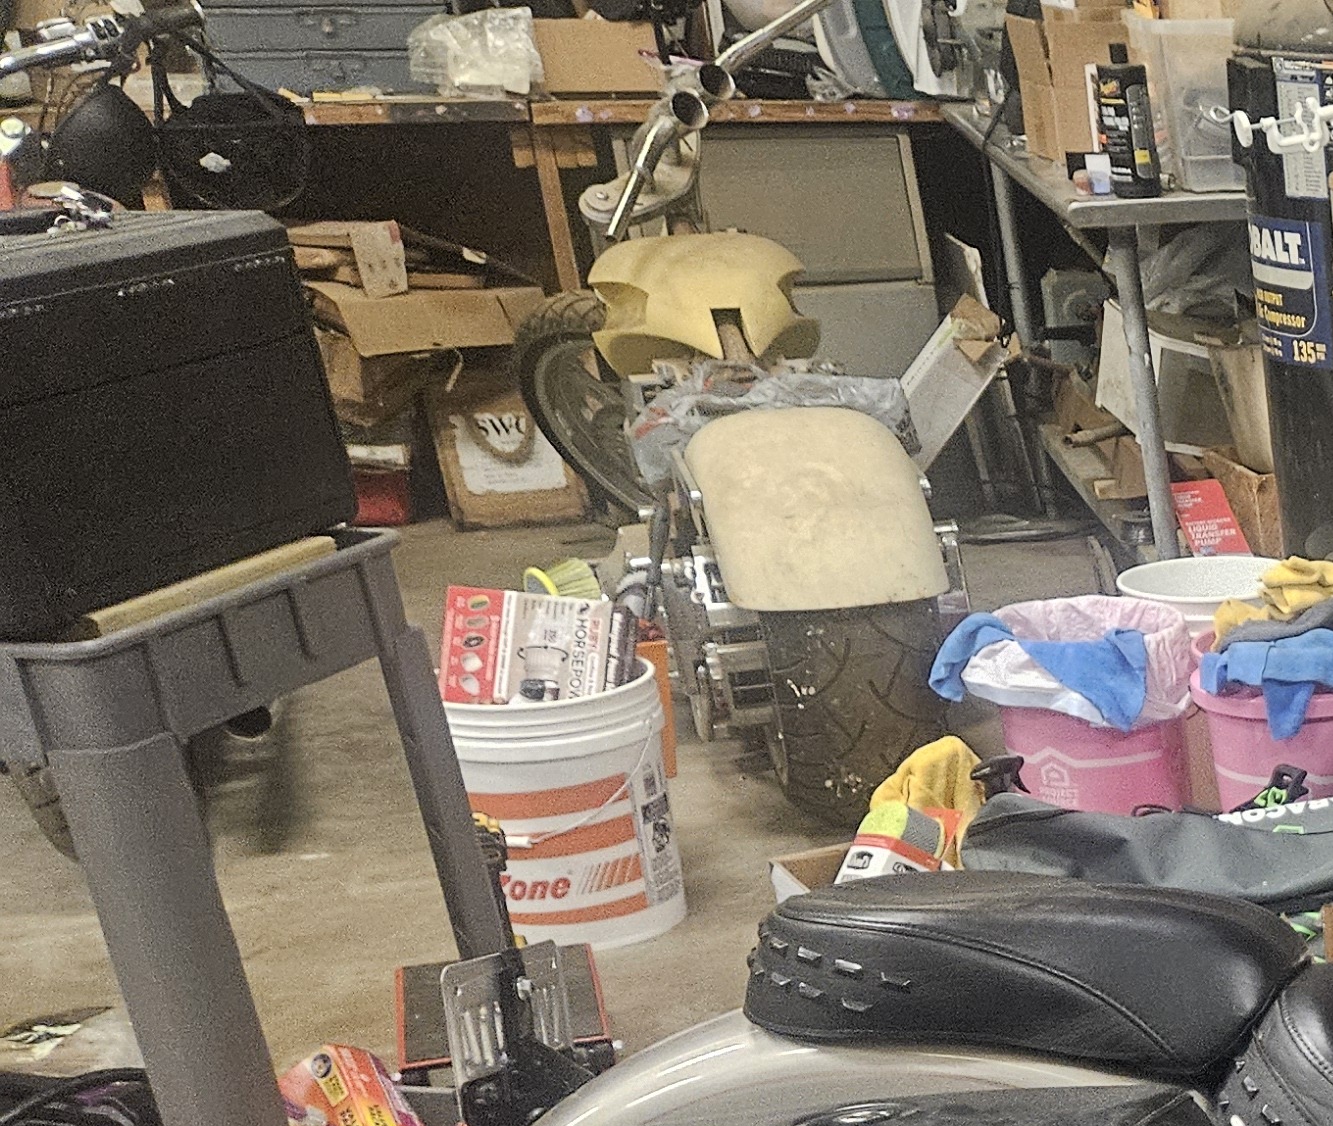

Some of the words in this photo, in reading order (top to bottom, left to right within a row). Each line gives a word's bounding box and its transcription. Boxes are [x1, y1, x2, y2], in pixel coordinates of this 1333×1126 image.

[1265, 305, 1306, 329] Compressor
[1293, 339, 1316, 364] 135
[1188, 523, 1218, 534] LIQUID
[1191, 528, 1237, 540] TRANSFER
